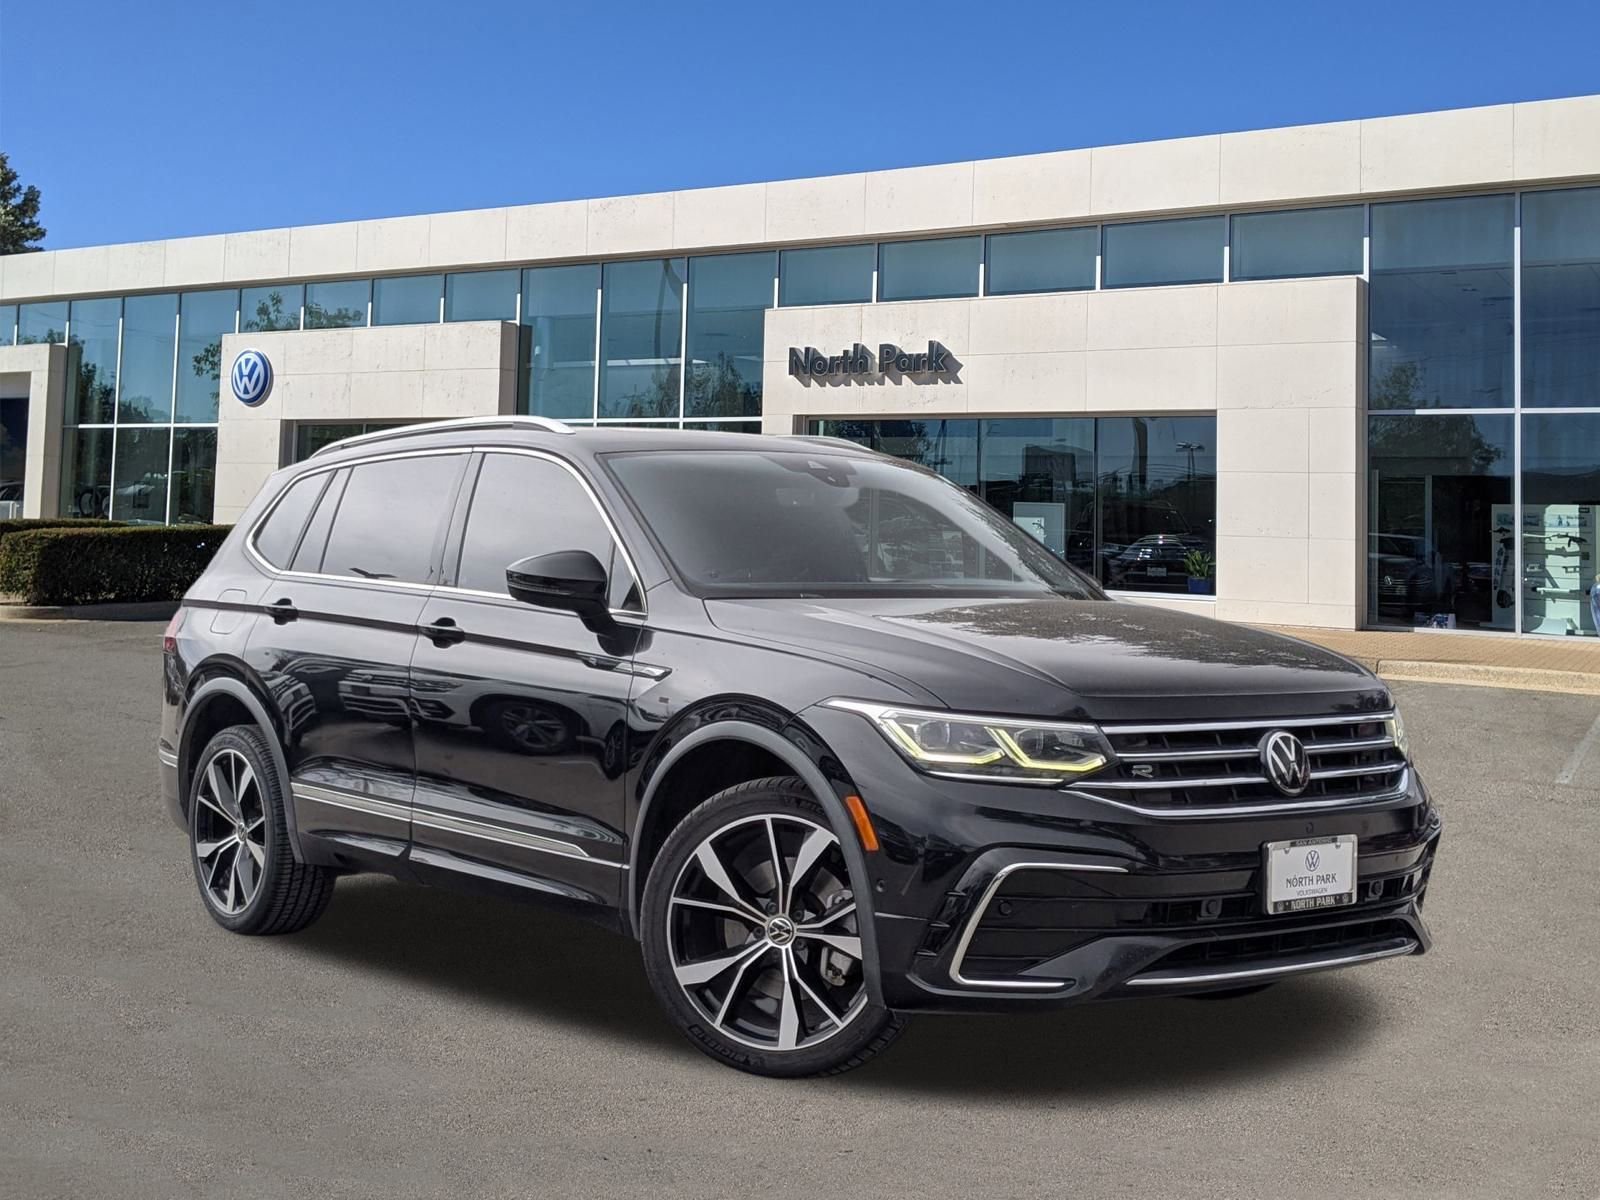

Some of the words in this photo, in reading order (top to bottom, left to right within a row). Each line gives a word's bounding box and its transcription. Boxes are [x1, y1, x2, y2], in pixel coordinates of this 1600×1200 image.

[788, 343, 869, 376] North
[879, 340, 947, 372] Park
[1285, 875, 1314, 888] NORTH
[1316, 873, 1337, 884] PARK
[1316, 895, 1336, 907] PARK
